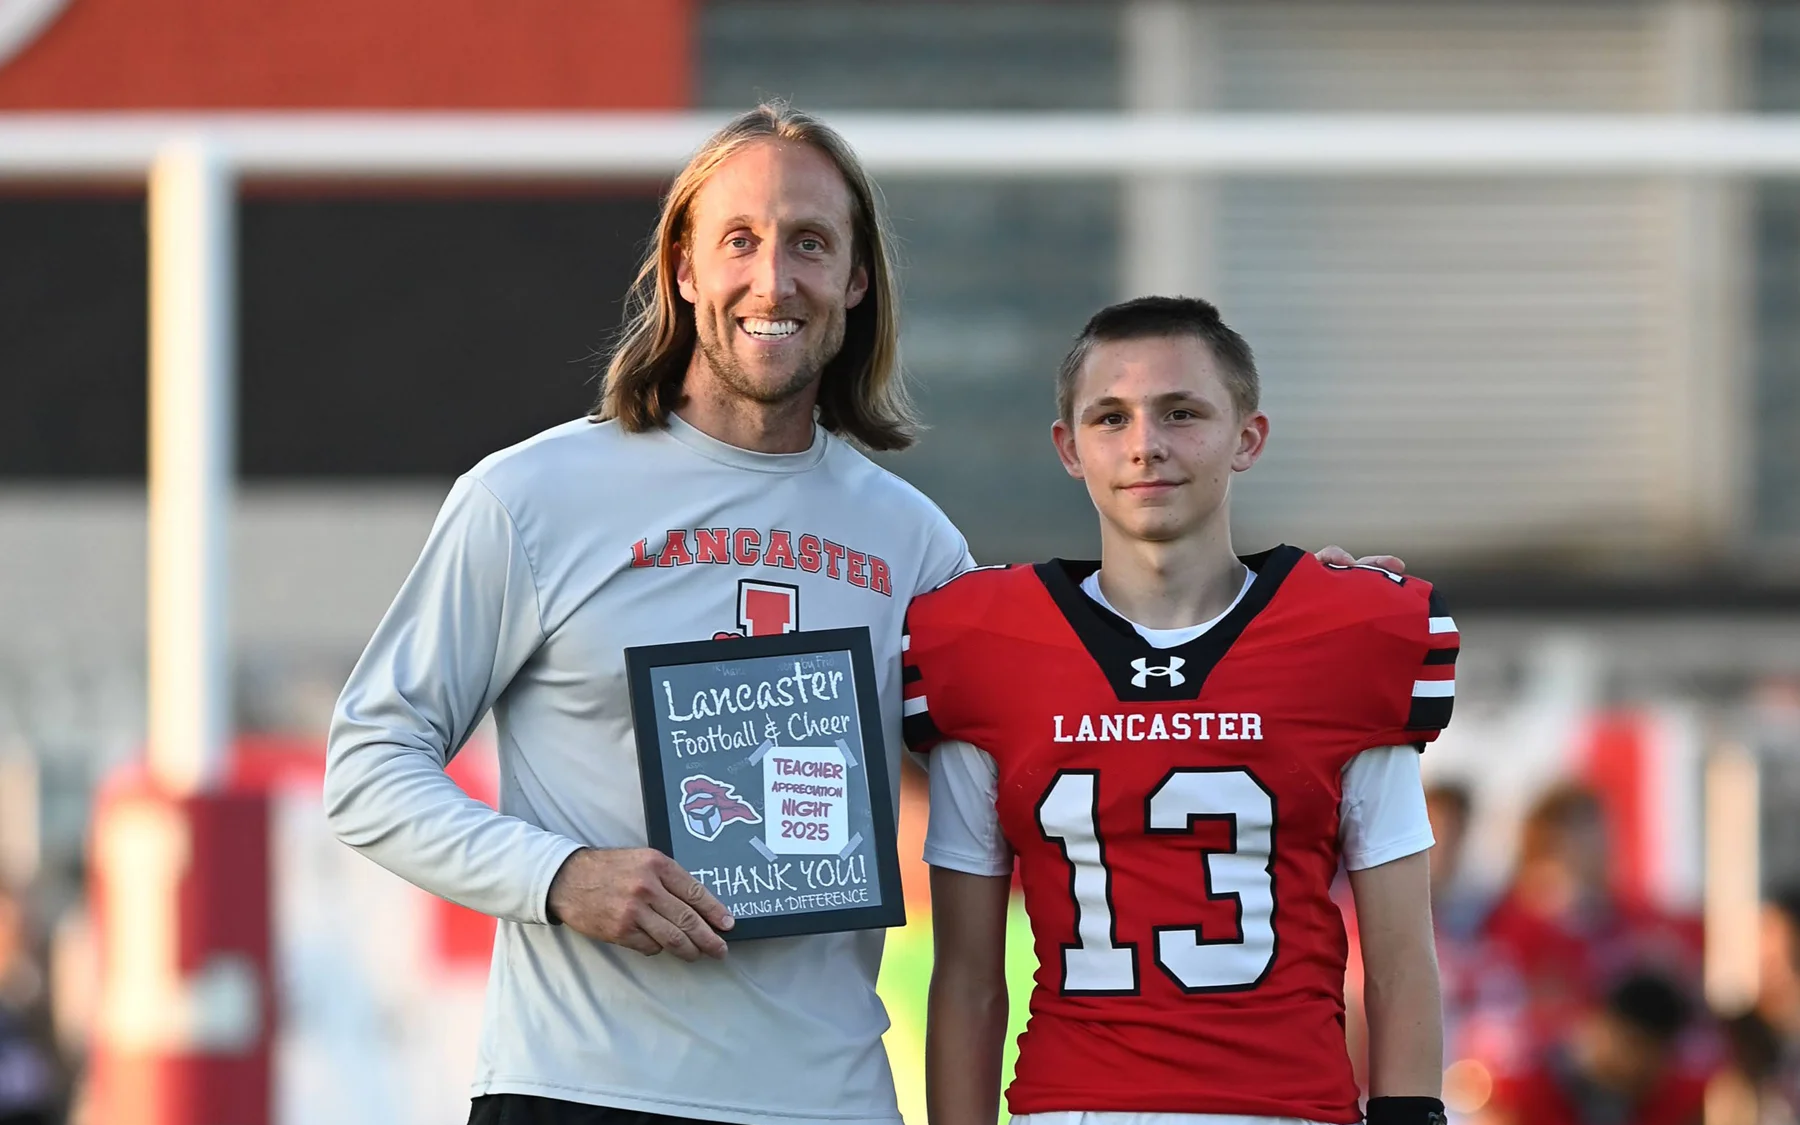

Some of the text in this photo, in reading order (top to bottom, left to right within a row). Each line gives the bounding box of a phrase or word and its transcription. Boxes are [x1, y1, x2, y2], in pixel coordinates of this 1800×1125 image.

[630, 528, 893, 597] LANCASTER
[662, 661, 844, 722] Lancaster
[671, 711, 850, 758] Football & Cheer
[1053, 713, 1264, 742] LANCASTER
[772, 757, 844, 780] TEACHER
[771, 780, 843, 798] APPRECIATION
[781, 798, 834, 818] NIGHT
[781, 820, 829, 841] 2025
[689, 854, 868, 897] THANK YOU!
[1034, 766, 1279, 996] 13
[728, 888, 869, 918] AKING A DIFFERENCE
